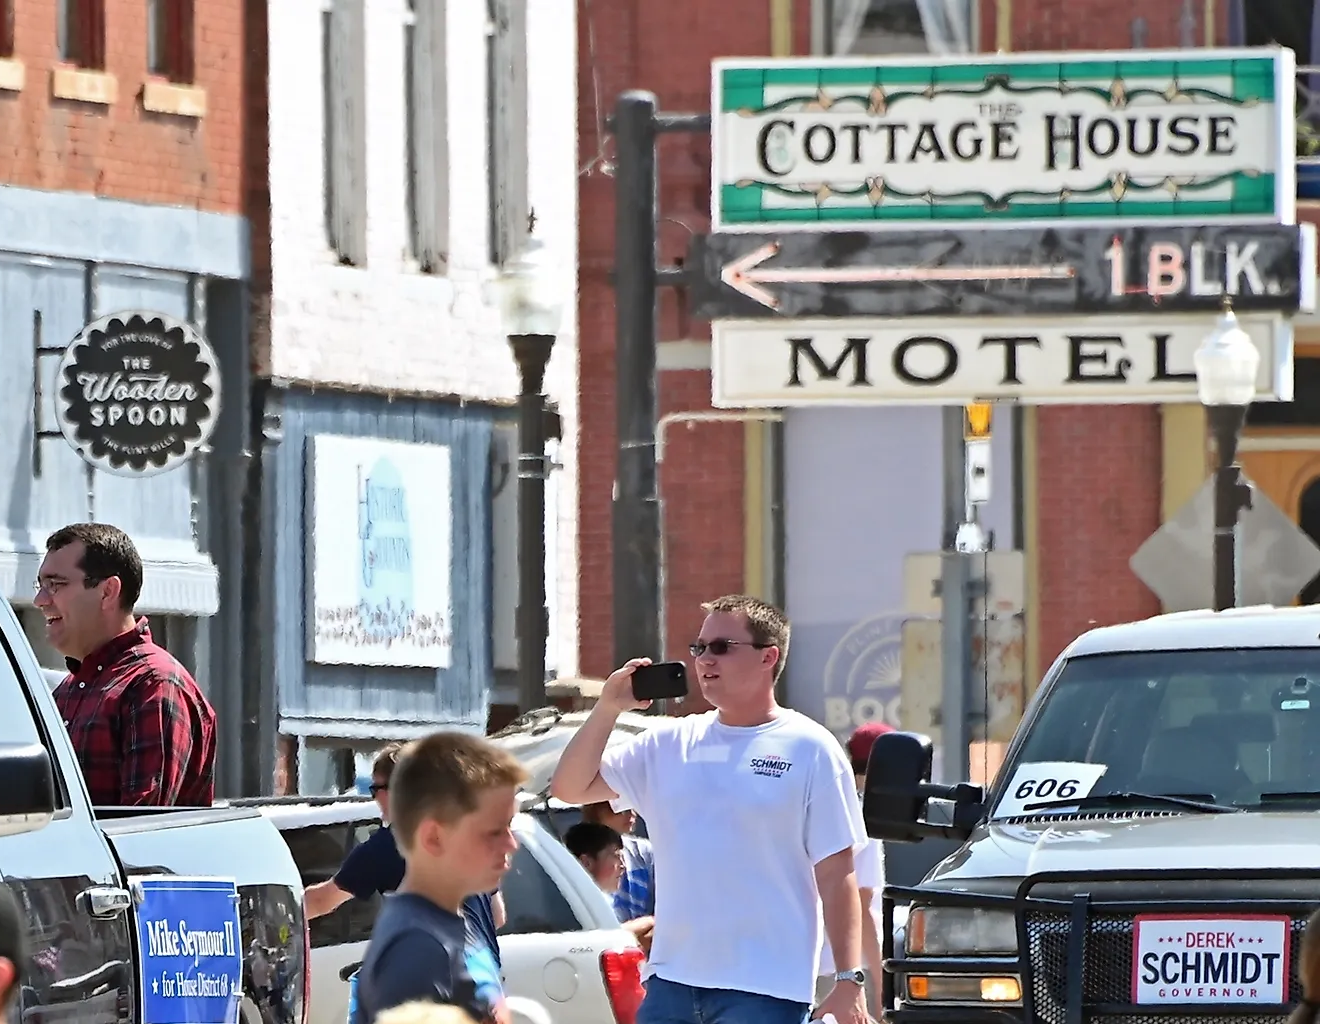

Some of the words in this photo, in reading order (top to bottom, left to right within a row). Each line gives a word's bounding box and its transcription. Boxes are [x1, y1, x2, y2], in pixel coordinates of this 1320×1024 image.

[976, 102, 1021, 117] THE
[756, 120, 1020, 176] COTTAGE
[1044, 113, 1237, 171] HOUSE
[1105, 235, 1123, 297] 1
[1147, 240, 1282, 297] BLK.
[100, 337, 120, 352] FOR
[120, 332, 137, 343] THE
[138, 333, 161, 346] LOVE
[122, 356, 152, 371] THE
[784, 333, 1198, 387] MOTEL
[76, 371, 199, 402] Wooden
[90, 404, 188, 427] SPOON
[102, 436, 119, 451] THE
[150, 435, 176, 453] HILLS
[749, 758, 793, 772] SCHMIDT
[1014, 778, 1081, 800] 606
[145, 918, 180, 957] Mike
[179, 919, 225, 968] Seymour
[225, 920, 236, 957] II
[1185, 931, 1236, 949] DEREK
[1141, 951, 1281, 985] SCHMIDT
[161, 970, 175, 998] for
[175, 971, 198, 998] House
[197, 972, 221, 998] District
[221, 973, 229, 998] 68
[1158, 987, 1258, 998] GOVERNOR
